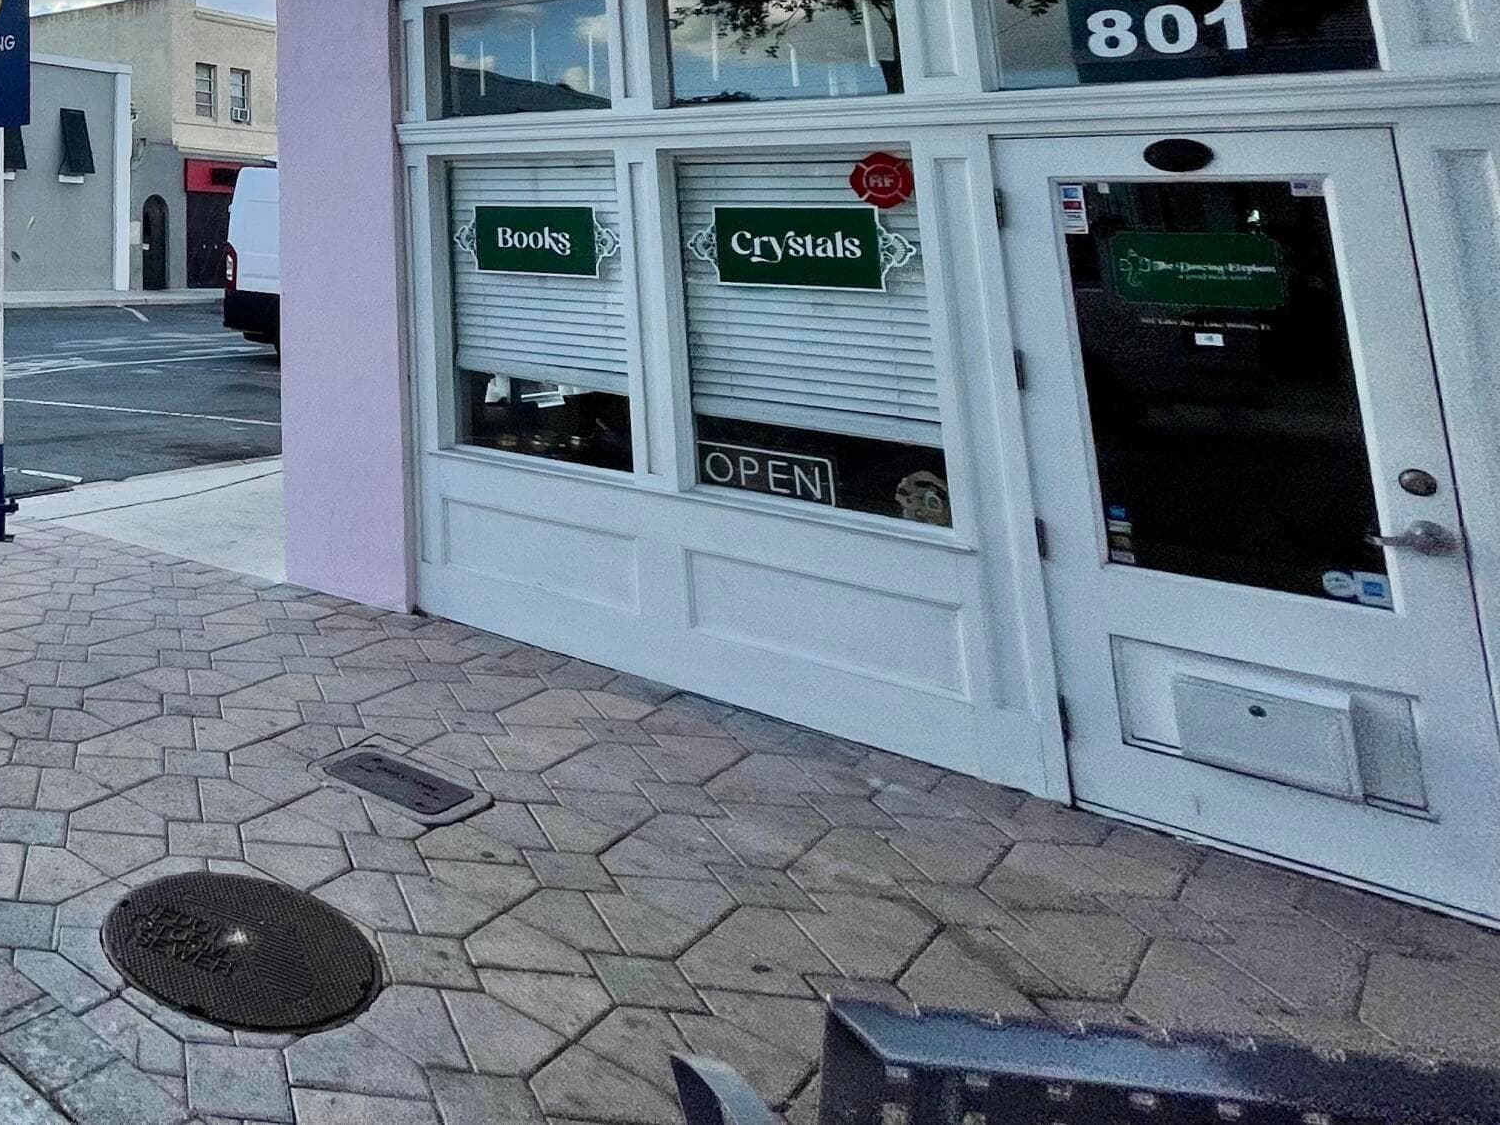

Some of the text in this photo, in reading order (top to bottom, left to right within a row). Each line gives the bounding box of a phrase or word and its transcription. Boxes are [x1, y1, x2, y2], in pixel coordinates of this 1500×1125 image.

[1086, 0, 1248, 58] 801
[497, 226, 571, 256] Books
[731, 230, 862, 264] Crystals
[705, 452, 822, 500] OPEN
